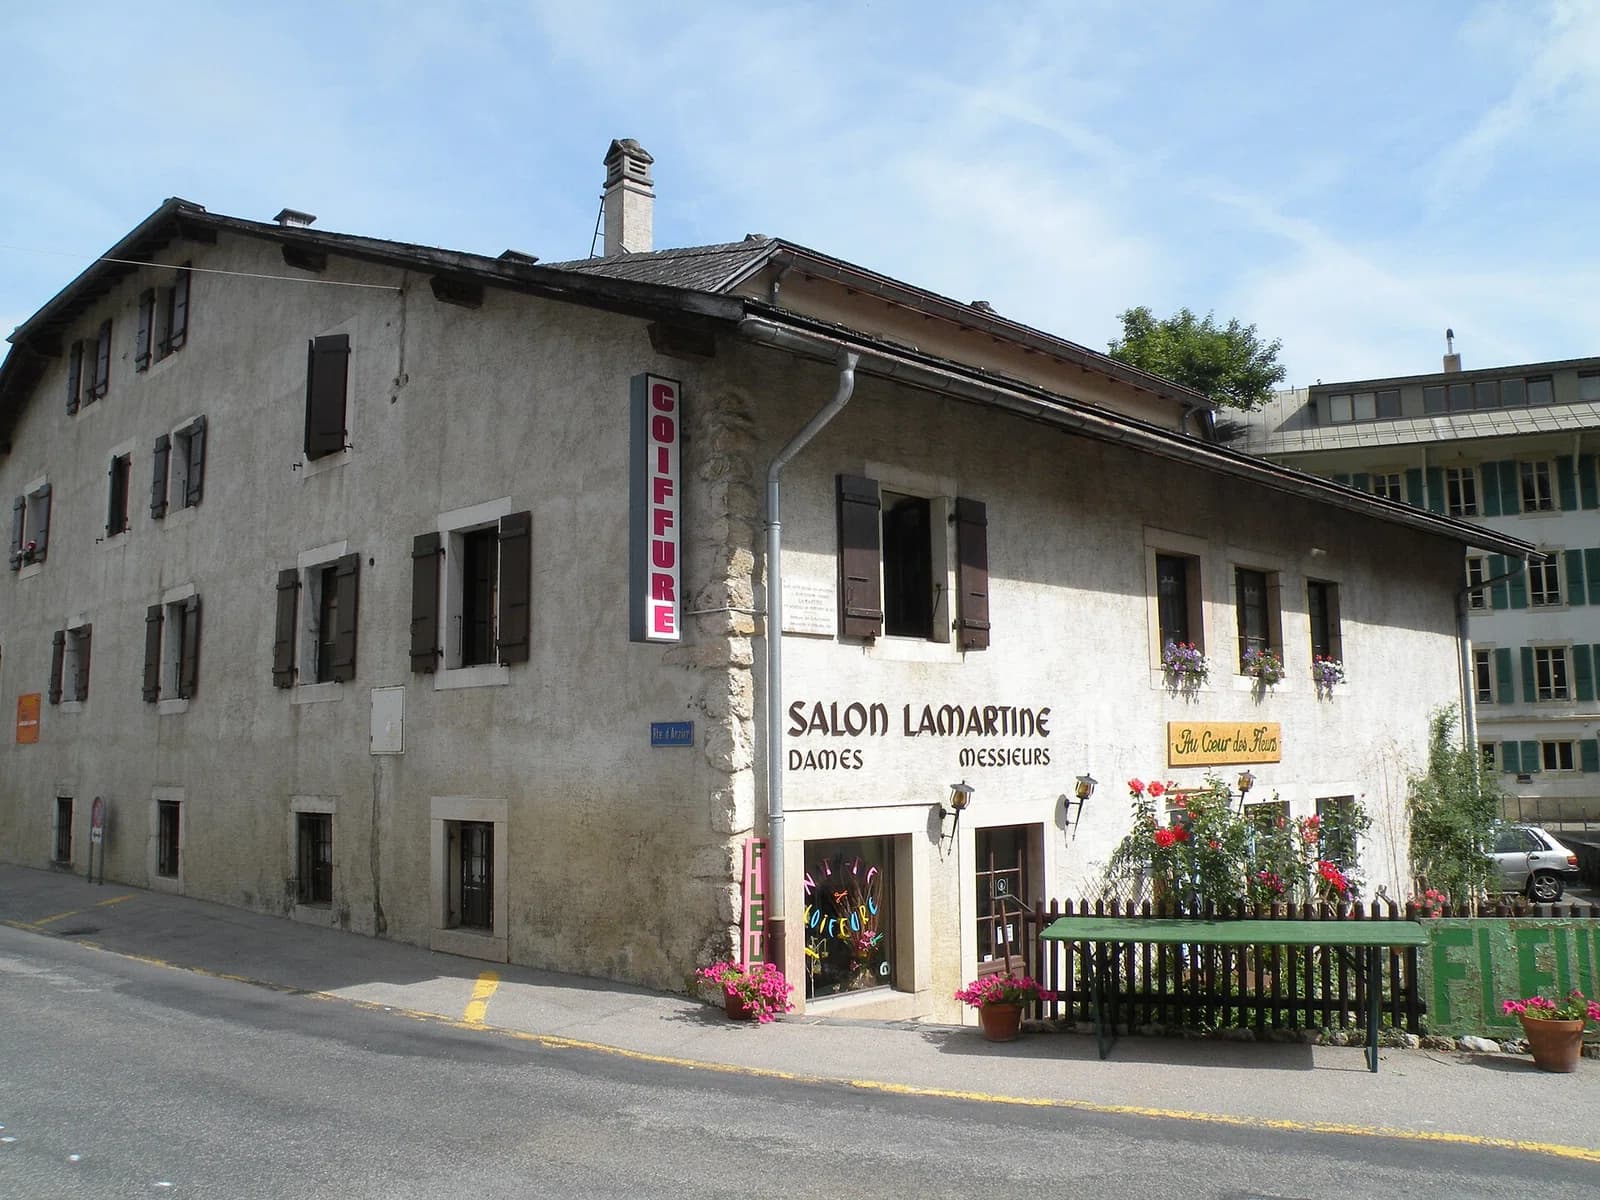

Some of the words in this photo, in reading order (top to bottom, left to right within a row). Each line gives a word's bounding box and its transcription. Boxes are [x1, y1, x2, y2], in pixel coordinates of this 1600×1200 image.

[652, 383, 675, 633] COIFFURE
[787, 701, 889, 737] SALON
[903, 703, 1051, 738] LAMARTINE
[1175, 729, 1199, 754] Au
[1233, 729, 1247, 752] des
[1249, 726, 1278, 753] Fleurs
[789, 748, 863, 771] DAMES
[959, 747, 1050, 767] MESSIEURS
